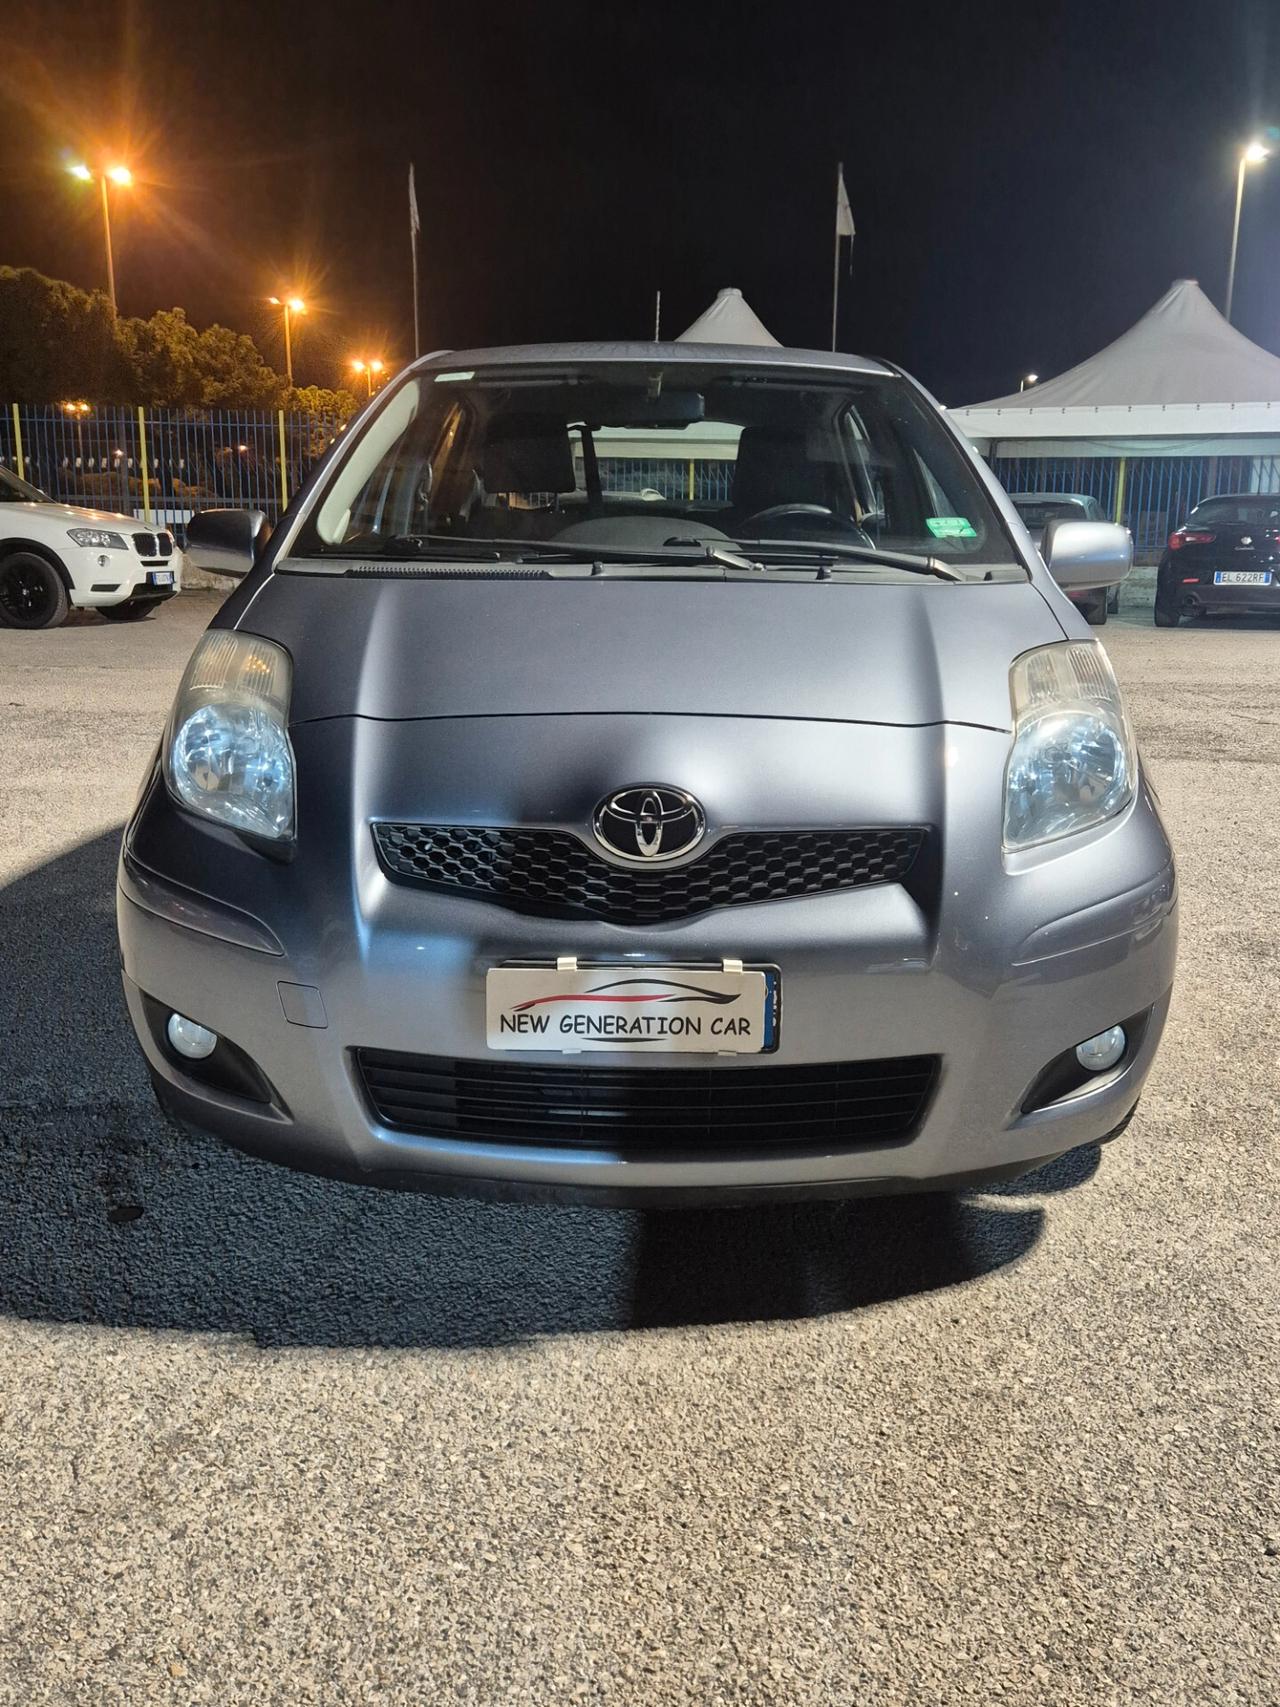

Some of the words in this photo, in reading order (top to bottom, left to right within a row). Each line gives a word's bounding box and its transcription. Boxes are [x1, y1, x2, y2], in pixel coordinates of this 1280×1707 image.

[500, 1014, 550, 1034] NEW
[559, 1015, 701, 1035] GENERATION
[710, 1017, 751, 1036] CAR
